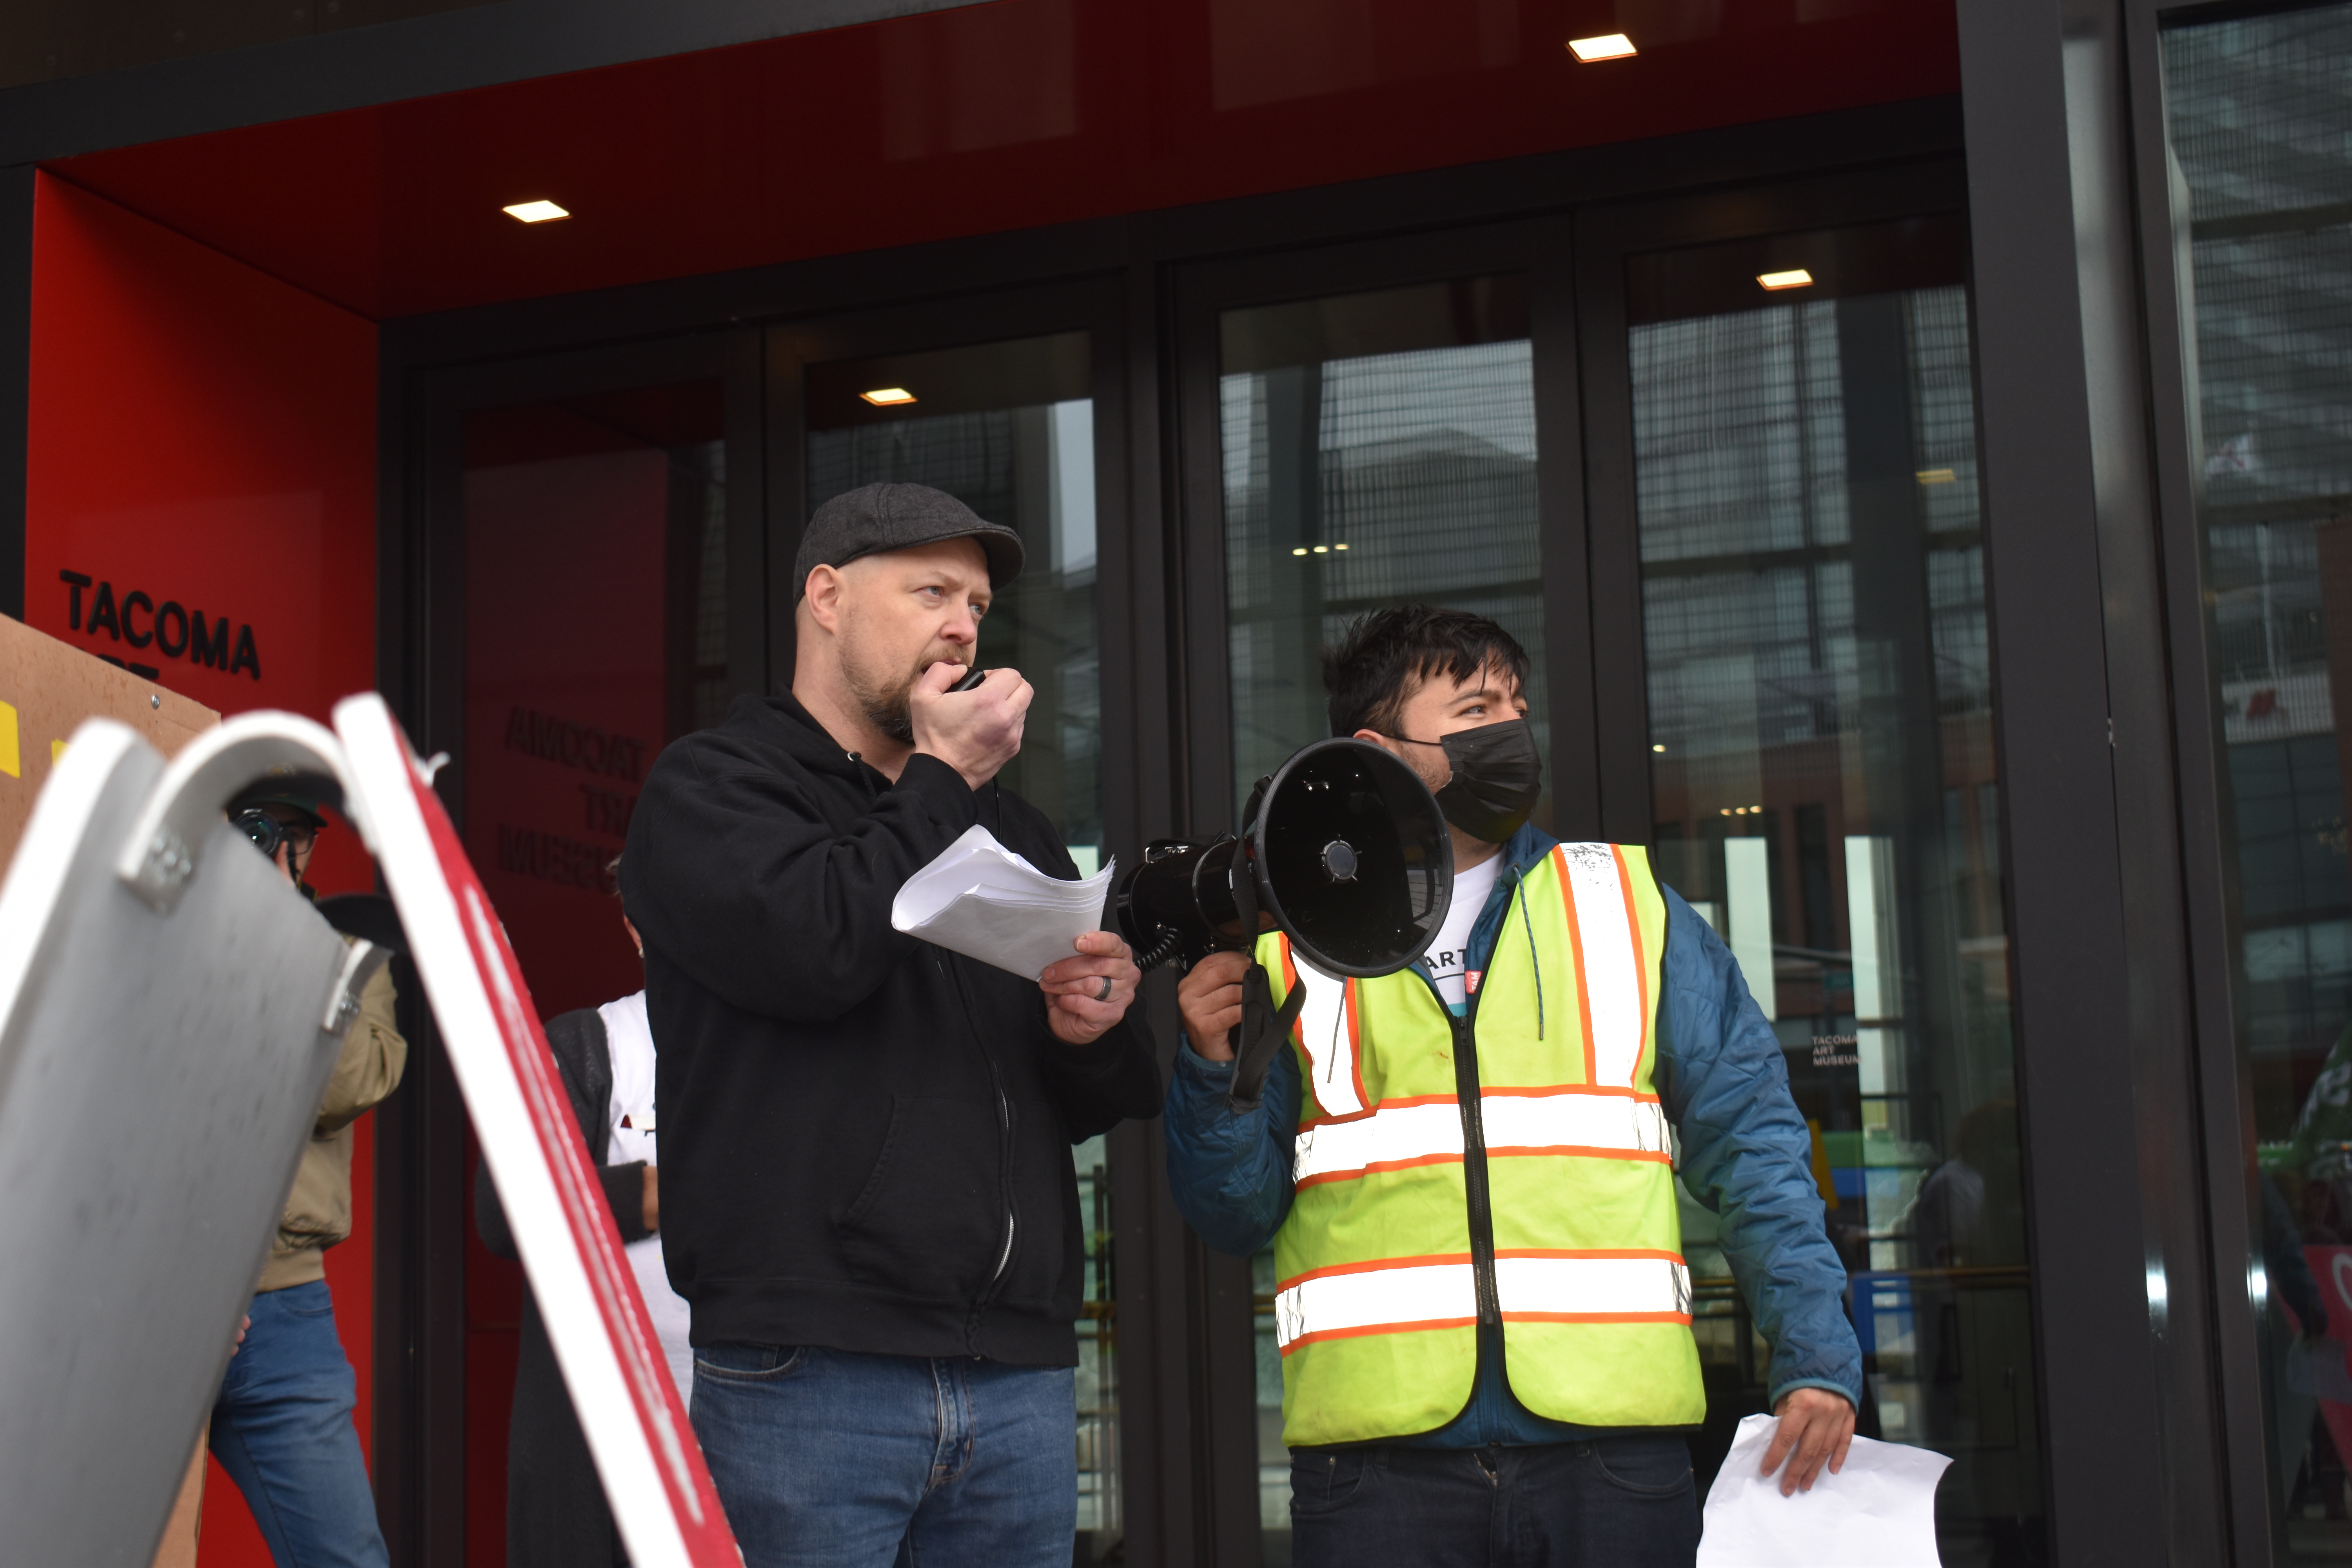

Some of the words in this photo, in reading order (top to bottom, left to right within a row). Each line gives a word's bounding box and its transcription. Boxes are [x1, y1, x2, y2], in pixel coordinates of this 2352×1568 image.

[60, 569, 261, 680] TACOMA
[1426, 949, 1466, 969] ART
[1812, 1035, 1858, 1045] TACOMA
[1813, 1045, 1835, 1055] ART
[1813, 1055, 1860, 1067] MUSEUM
